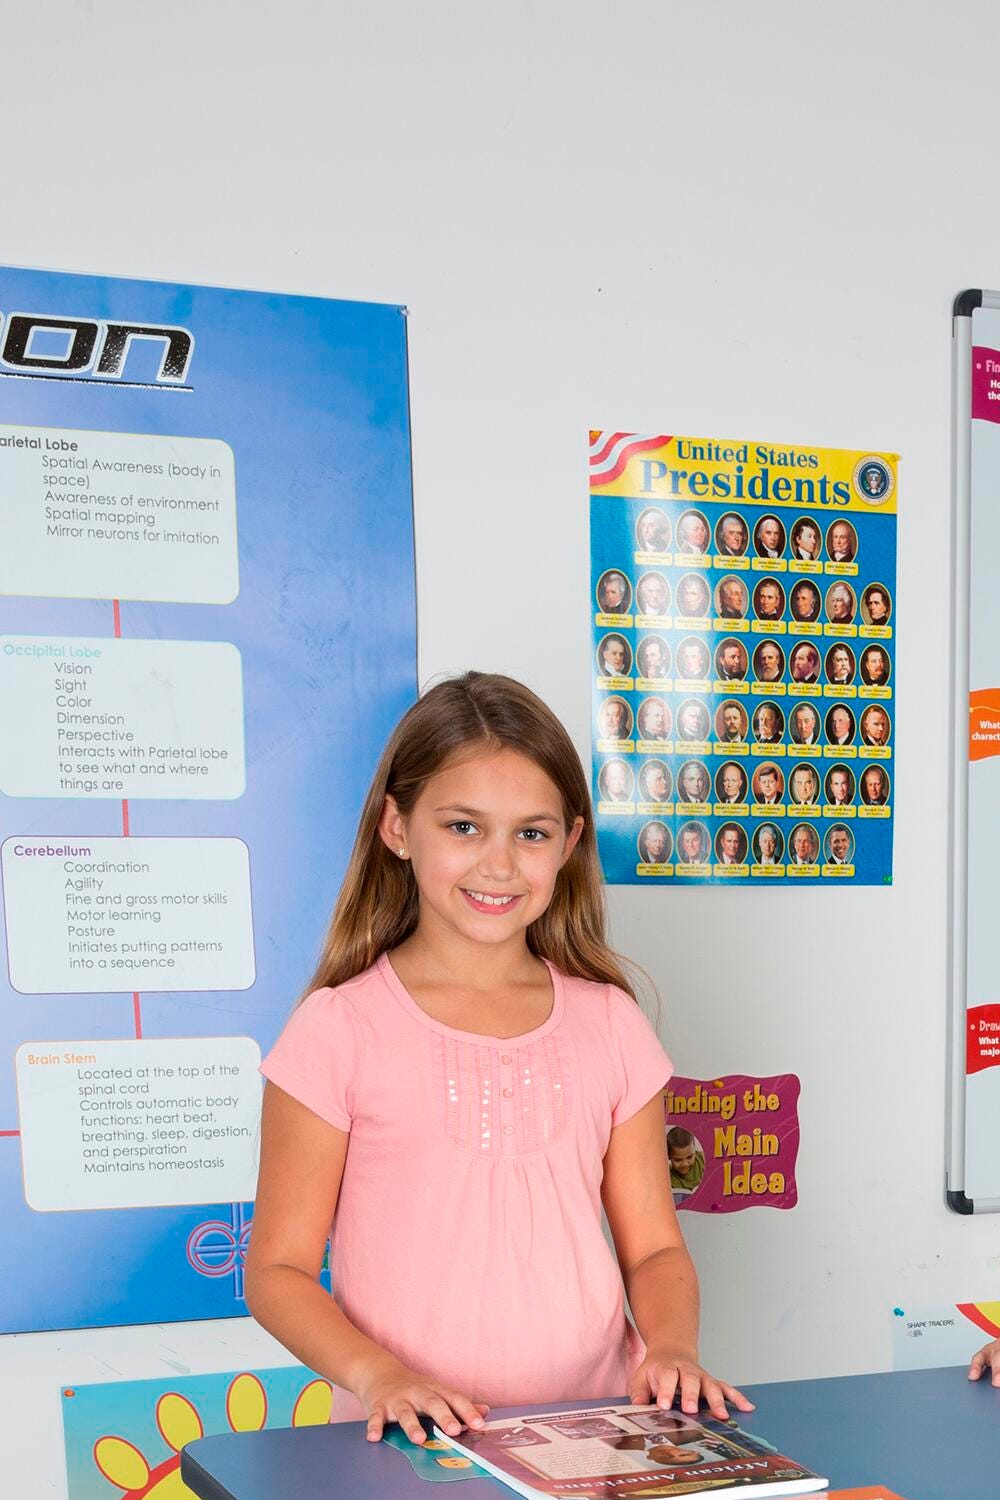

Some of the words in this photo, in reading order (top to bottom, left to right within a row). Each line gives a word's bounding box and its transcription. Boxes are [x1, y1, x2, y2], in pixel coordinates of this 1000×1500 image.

[0, 311, 195, 382] on
[987, 391, 1000, 400] the
[0, 435, 41, 450] arietal
[45, 437, 78, 452] Lobe
[676, 440, 748, 464] United
[756, 445, 818, 469] States
[42, 455, 88, 472] Spatial
[92, 459, 164, 475] Awareness
[167, 462, 206, 480] (body
[210, 465, 221, 479] in
[43, 473, 90, 489] space)
[640, 459, 851, 506] Presidents
[44, 490, 117, 506] Awareness
[120, 493, 134, 507] of
[138, 496, 220, 512] environment
[45, 507, 91, 525] Spatial
[95, 511, 156, 527] mapping
[46, 525, 84, 539] Mirror
[87, 529, 139, 541] neurons
[143, 528, 160, 542] for
[163, 530, 220, 545] imitation
[4, 643, 65, 659] Occipital
[70, 647, 101, 658] Lobe
[54, 662, 92, 675] Vision
[55, 679, 87, 693] Sight
[56, 695, 92, 708] Color
[57, 712, 124, 725] Dimension
[980, 721, 1000, 729] What
[57, 729, 134, 743] Perspective
[58, 746, 115, 758] Interacts
[120, 746, 145, 758] with
[149, 747, 197, 759] Parietal
[199, 747, 228, 759] lobe
[59, 763, 72, 774] to
[76, 764, 99, 774] see
[103, 763, 136, 774] what
[140, 763, 165, 775] and
[169, 763, 209, 775] where
[60, 778, 98, 792] things
[102, 780, 123, 790] are
[14, 845, 91, 857] Cerebellum
[63, 861, 149, 873] Coordination
[65, 878, 103, 891] Agility
[65, 893, 92, 905] Fine
[96, 893, 122, 905] and
[126, 895, 158, 907] gross
[161, 893, 199, 905] motor
[203, 893, 228, 904] skills
[67, 910, 105, 921] Motor
[109, 909, 161, 922] learning
[68, 926, 115, 937] Posture
[68, 942, 118, 953] Initiates
[121, 941, 167, 955] putting
[171, 941, 223, 954] patterns
[69, 957, 94, 969] into
[97, 960, 107, 968] a
[110, 958, 176, 970] sequence
[979, 1037, 999, 1045] What
[28, 1054, 60, 1065] Brain
[64, 1053, 97, 1064] Stem
[77, 1067, 132, 1080] Located
[136, 1067, 149, 1078] at
[153, 1066, 174, 1078] the
[178, 1066, 200, 1080] top
[203, 1065, 215, 1077] of
[219, 1064, 240, 1076] the
[78, 1084, 116, 1097] spinal
[119, 1083, 149, 1095] cord
[80, 1099, 133, 1112] Controls
[136, 1097, 202, 1111] automatic
[206, 1096, 239, 1109] body
[743, 1084, 780, 1112] the
[81, 1113, 143, 1127] functions:
[146, 1112, 180, 1125] heart
[183, 1111, 216, 1124] beat,
[82, 1130, 148, 1143] breathing,
[152, 1128, 189, 1141] sleep,
[192, 1126, 252, 1139] digestion,
[714, 1125, 779, 1157] Main
[83, 1146, 109, 1158] and
[113, 1143, 187, 1159] perspiration
[84, 1161, 145, 1173] Maintains
[149, 1157, 225, 1170] homeostasis
[723, 1160, 785, 1196] Idea
[684, 1461, 769, 1476] African
[553, 1473, 676, 1490] Americans
